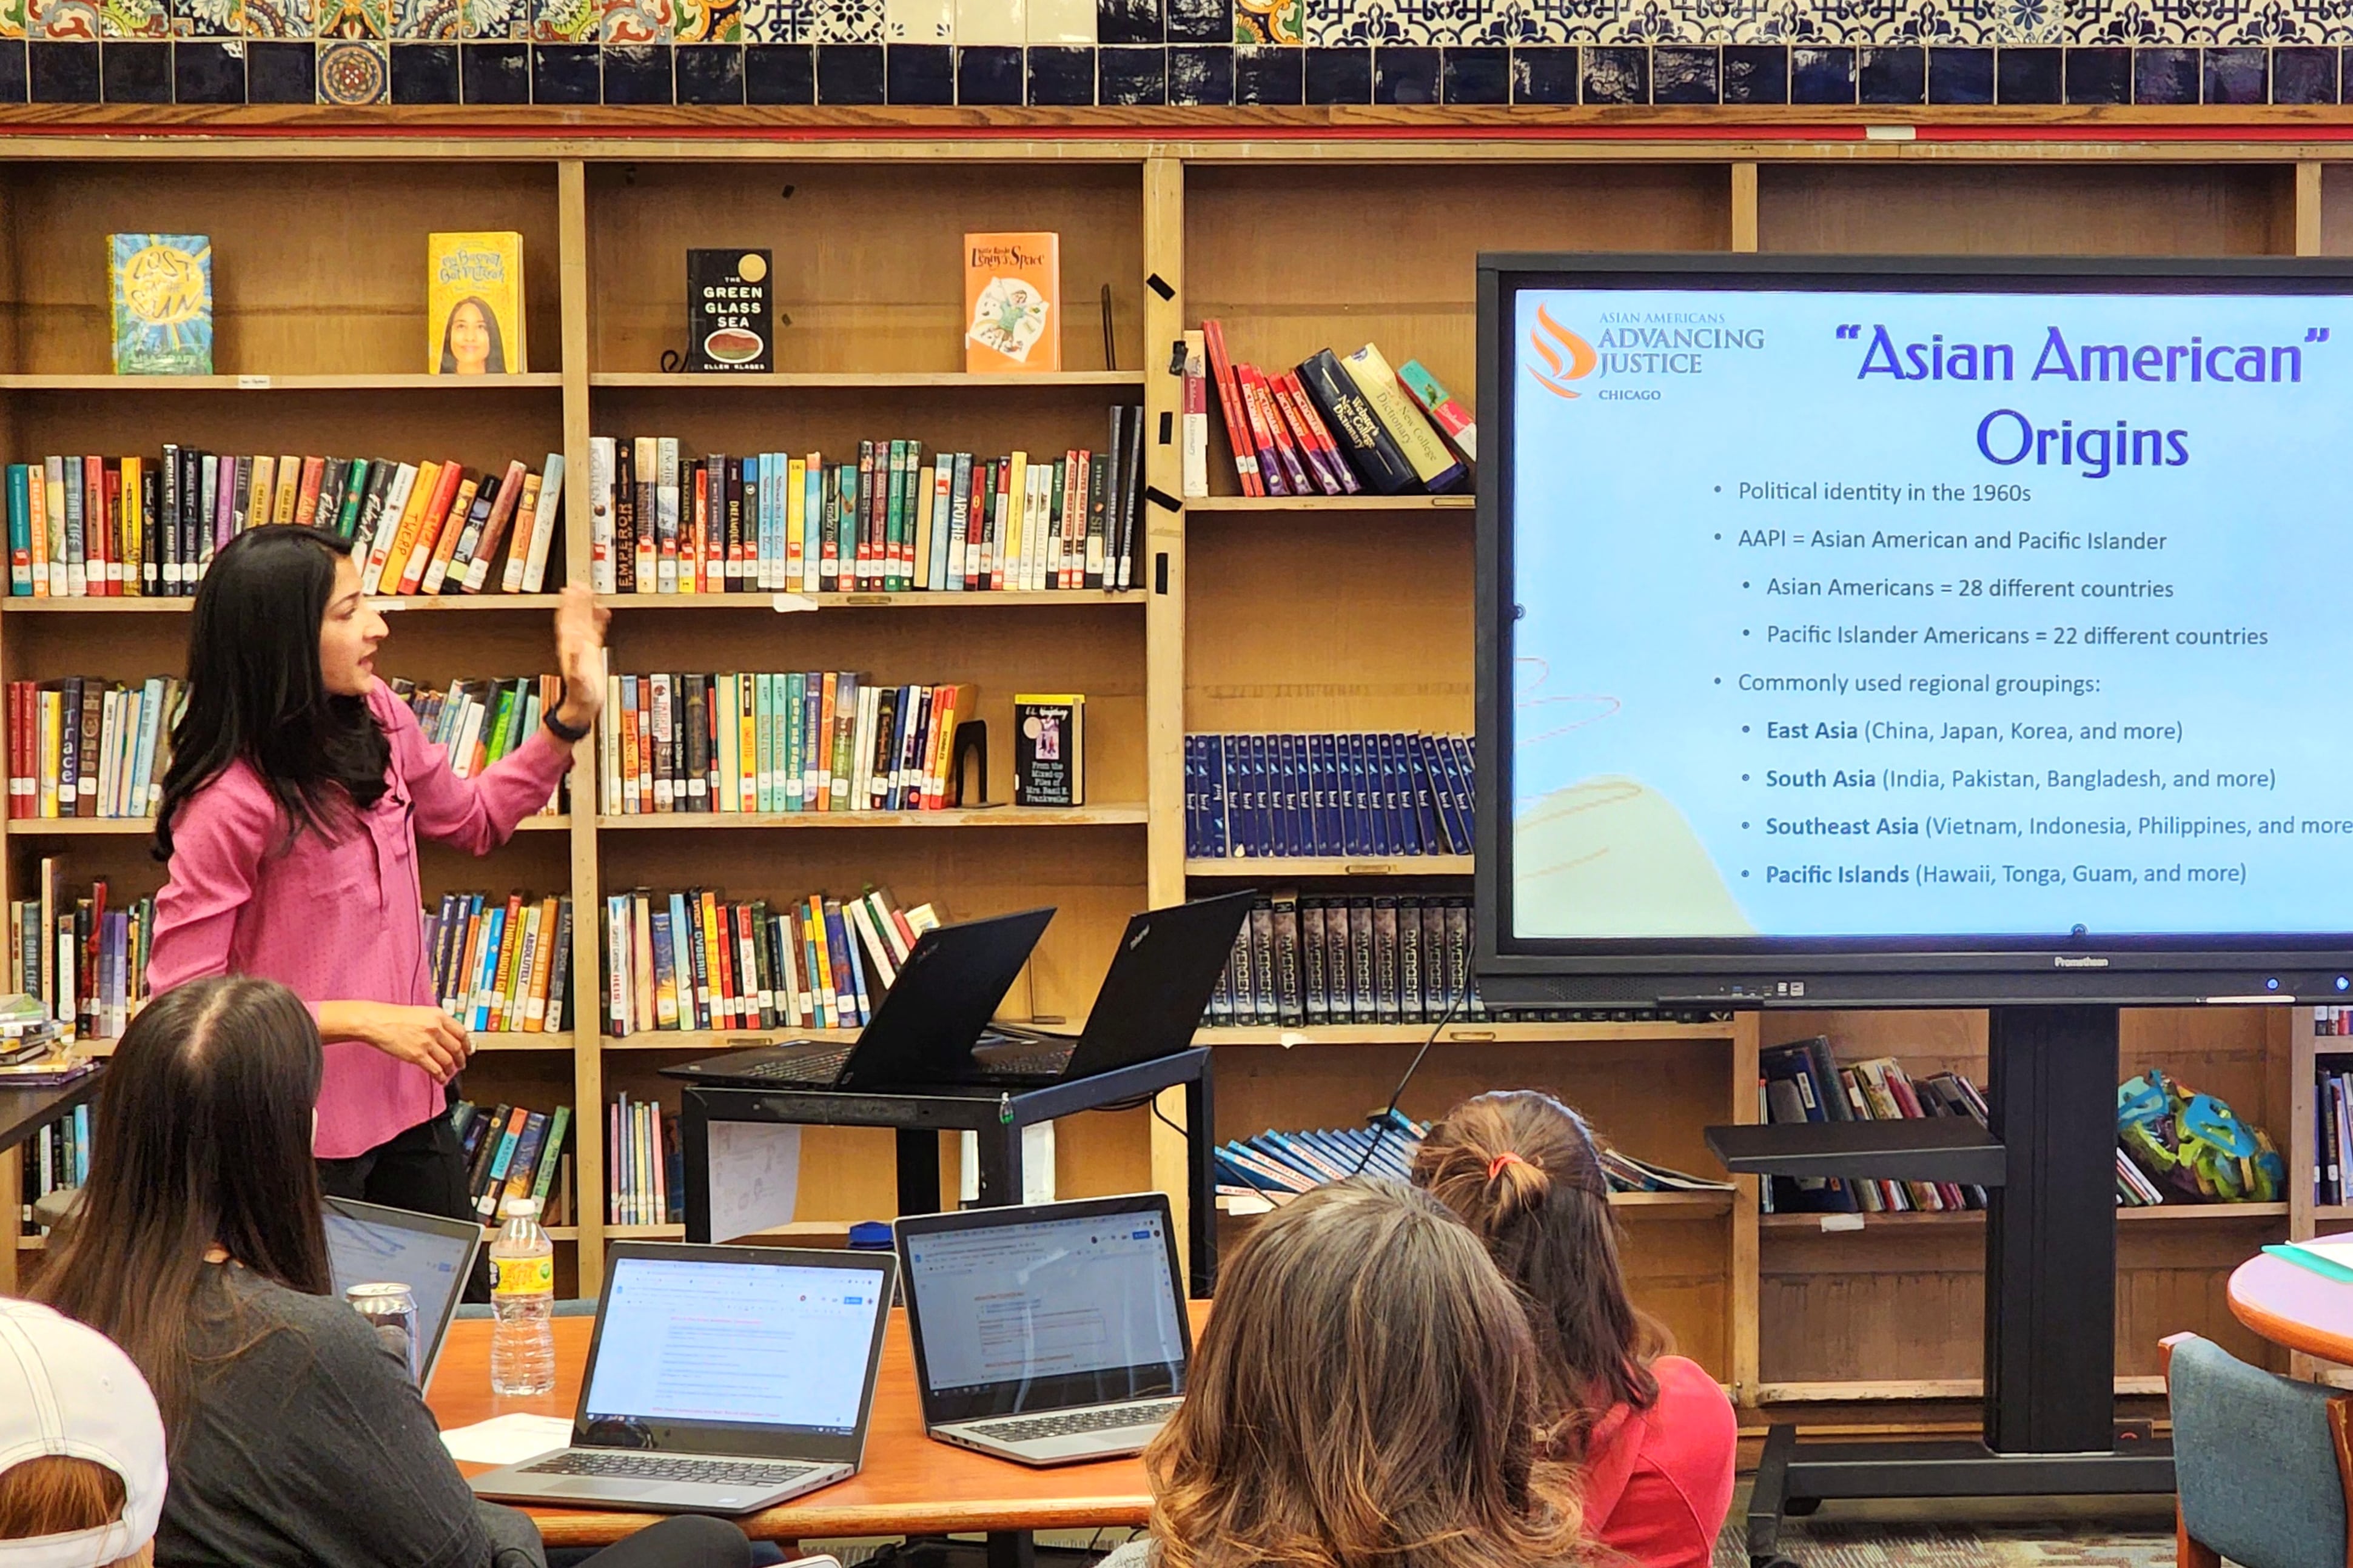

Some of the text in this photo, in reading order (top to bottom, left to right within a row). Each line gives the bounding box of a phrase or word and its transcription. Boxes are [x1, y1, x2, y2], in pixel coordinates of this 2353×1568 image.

[133, 251, 192, 281] LOST
[132, 290, 200, 318] SUN
[703, 287, 762, 298] GREEN
[705, 303, 761, 313] GLASS
[718, 317, 749, 327] SEA
[1599, 313, 1725, 324] ASIAN AMERICANS
[1599, 329, 1764, 349] ADVANCING
[1836, 324, 2329, 382] “Asian American”
[1601, 353, 1702, 377] JUSTICE
[1243, 383, 1262, 433] DICTIONARY
[1599, 390, 1660, 400] CHICAGO
[1257, 387, 1281, 435] DICTIONARY
[1276, 392, 1305, 438] DICTIONARY
[1292, 390, 1323, 436] DICTIONARY
[1338, 394, 1375, 449] New College
[1352, 396, 1379, 436] Webster's
[1377, 392, 1413, 444] Dictionary
[1333, 404, 1364, 449] Dictionary
[1400, 406, 1437, 461] New College
[1977, 409, 2189, 478] Origins
[186, 461, 195, 491] MICHAEL
[1740, 481, 2030, 504] Political identity in the 1960s
[422, 512, 440, 547] TWER
[825, 503, 834, 528] tender
[952, 496, 967, 541] APOTHE
[398, 513, 418, 556] TWERP
[618, 504, 627, 586] EMPEROR
[1739, 530, 1785, 546] AAPI
[1811, 530, 1865, 548] Asian
[1872, 531, 1967, 548] American
[1975, 531, 2010, 548] and
[2019, 531, 2081, 549] Pacific
[2089, 532, 2167, 549] Islander
[1767, 578, 1821, 595] Asian
[1828, 578, 1934, 596] Americans
[1959, 580, 1982, 596] 28
[1989, 578, 2075, 597] different
[2081, 580, 2173, 597] countries
[1768, 625, 1831, 643] Pacific
[1839, 625, 1918, 643] Islander
[1924, 626, 2029, 644] Americans
[2054, 628, 2077, 644] 22
[2084, 626, 2169, 644] different
[2176, 628, 2267, 645] countries
[1739, 673, 2100, 696] Commonly used regional groupings:
[62, 709, 75, 782] Trace
[1768, 720, 2182, 743] East Asia (China, Japan, Korea, and more)
[1213, 783, 1221, 800] bird
[1767, 769, 2275, 791] South Asia (India, Pakistan, Bangladesh, and more)
[1200, 794, 1209, 811] bird
[1243, 792, 1252, 809] bird
[1258, 792, 1266, 809] bird
[1272, 791, 1281, 809] bird
[1286, 794, 1296, 811] bird
[1767, 817, 1870, 834] Southeast
[1876, 817, 1918, 834] Asia
[1926, 817, 2022, 838] (Vietnam,
[2031, 817, 2131, 837] Indonesia,
[2139, 816, 2251, 837] Philippines,
[2259, 817, 2294, 833] and
[1767, 863, 2245, 886] Pacific Islands (Hawaii, Tonga, Guam, and more)
[499, 951, 510, 980] ABOUT
[520, 932, 535, 985] ABSOLUTELY
[1235, 933, 1249, 1005] DIVERGENT
[1260, 932, 1272, 1006] DIVERGENT
[1281, 934, 1296, 1008] DIVERGENT
[1311, 932, 1322, 1005] DIVERGENT
[1358, 930, 1370, 1004] DIVERGENT
[496, 1138, 513, 1173] MASCOT
